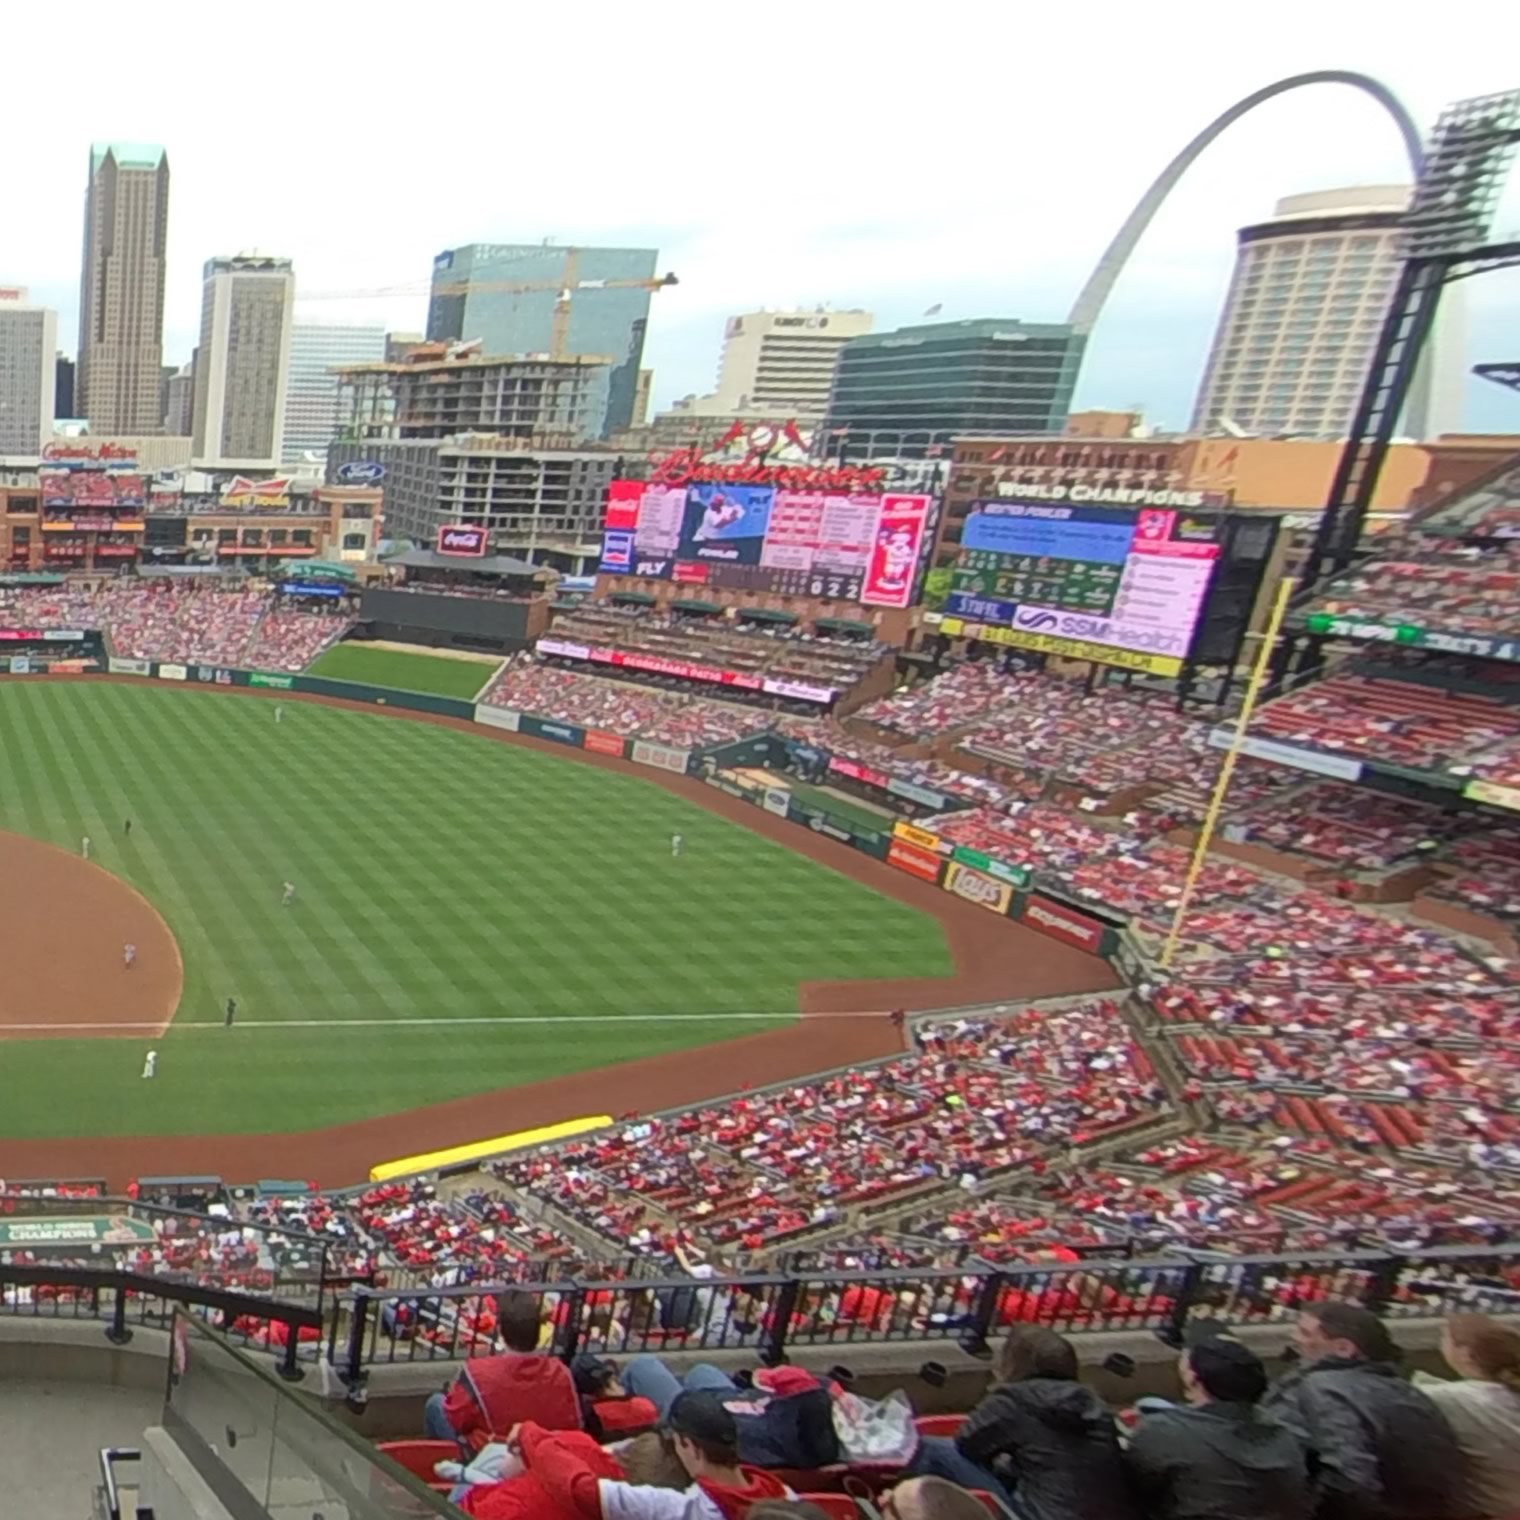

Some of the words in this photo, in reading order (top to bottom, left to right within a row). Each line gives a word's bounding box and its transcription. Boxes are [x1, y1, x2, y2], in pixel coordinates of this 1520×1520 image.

[998, 482, 1067, 498] WORLD
[1068, 485, 1203, 506] CHAMPIONS
[636, 561, 667, 576] FLY
[810, 580, 823, 595] 0
[827, 582, 841, 597] 2
[845, 584, 859, 599] 2
[8, 1230, 97, 1240] CHAMPIONS
